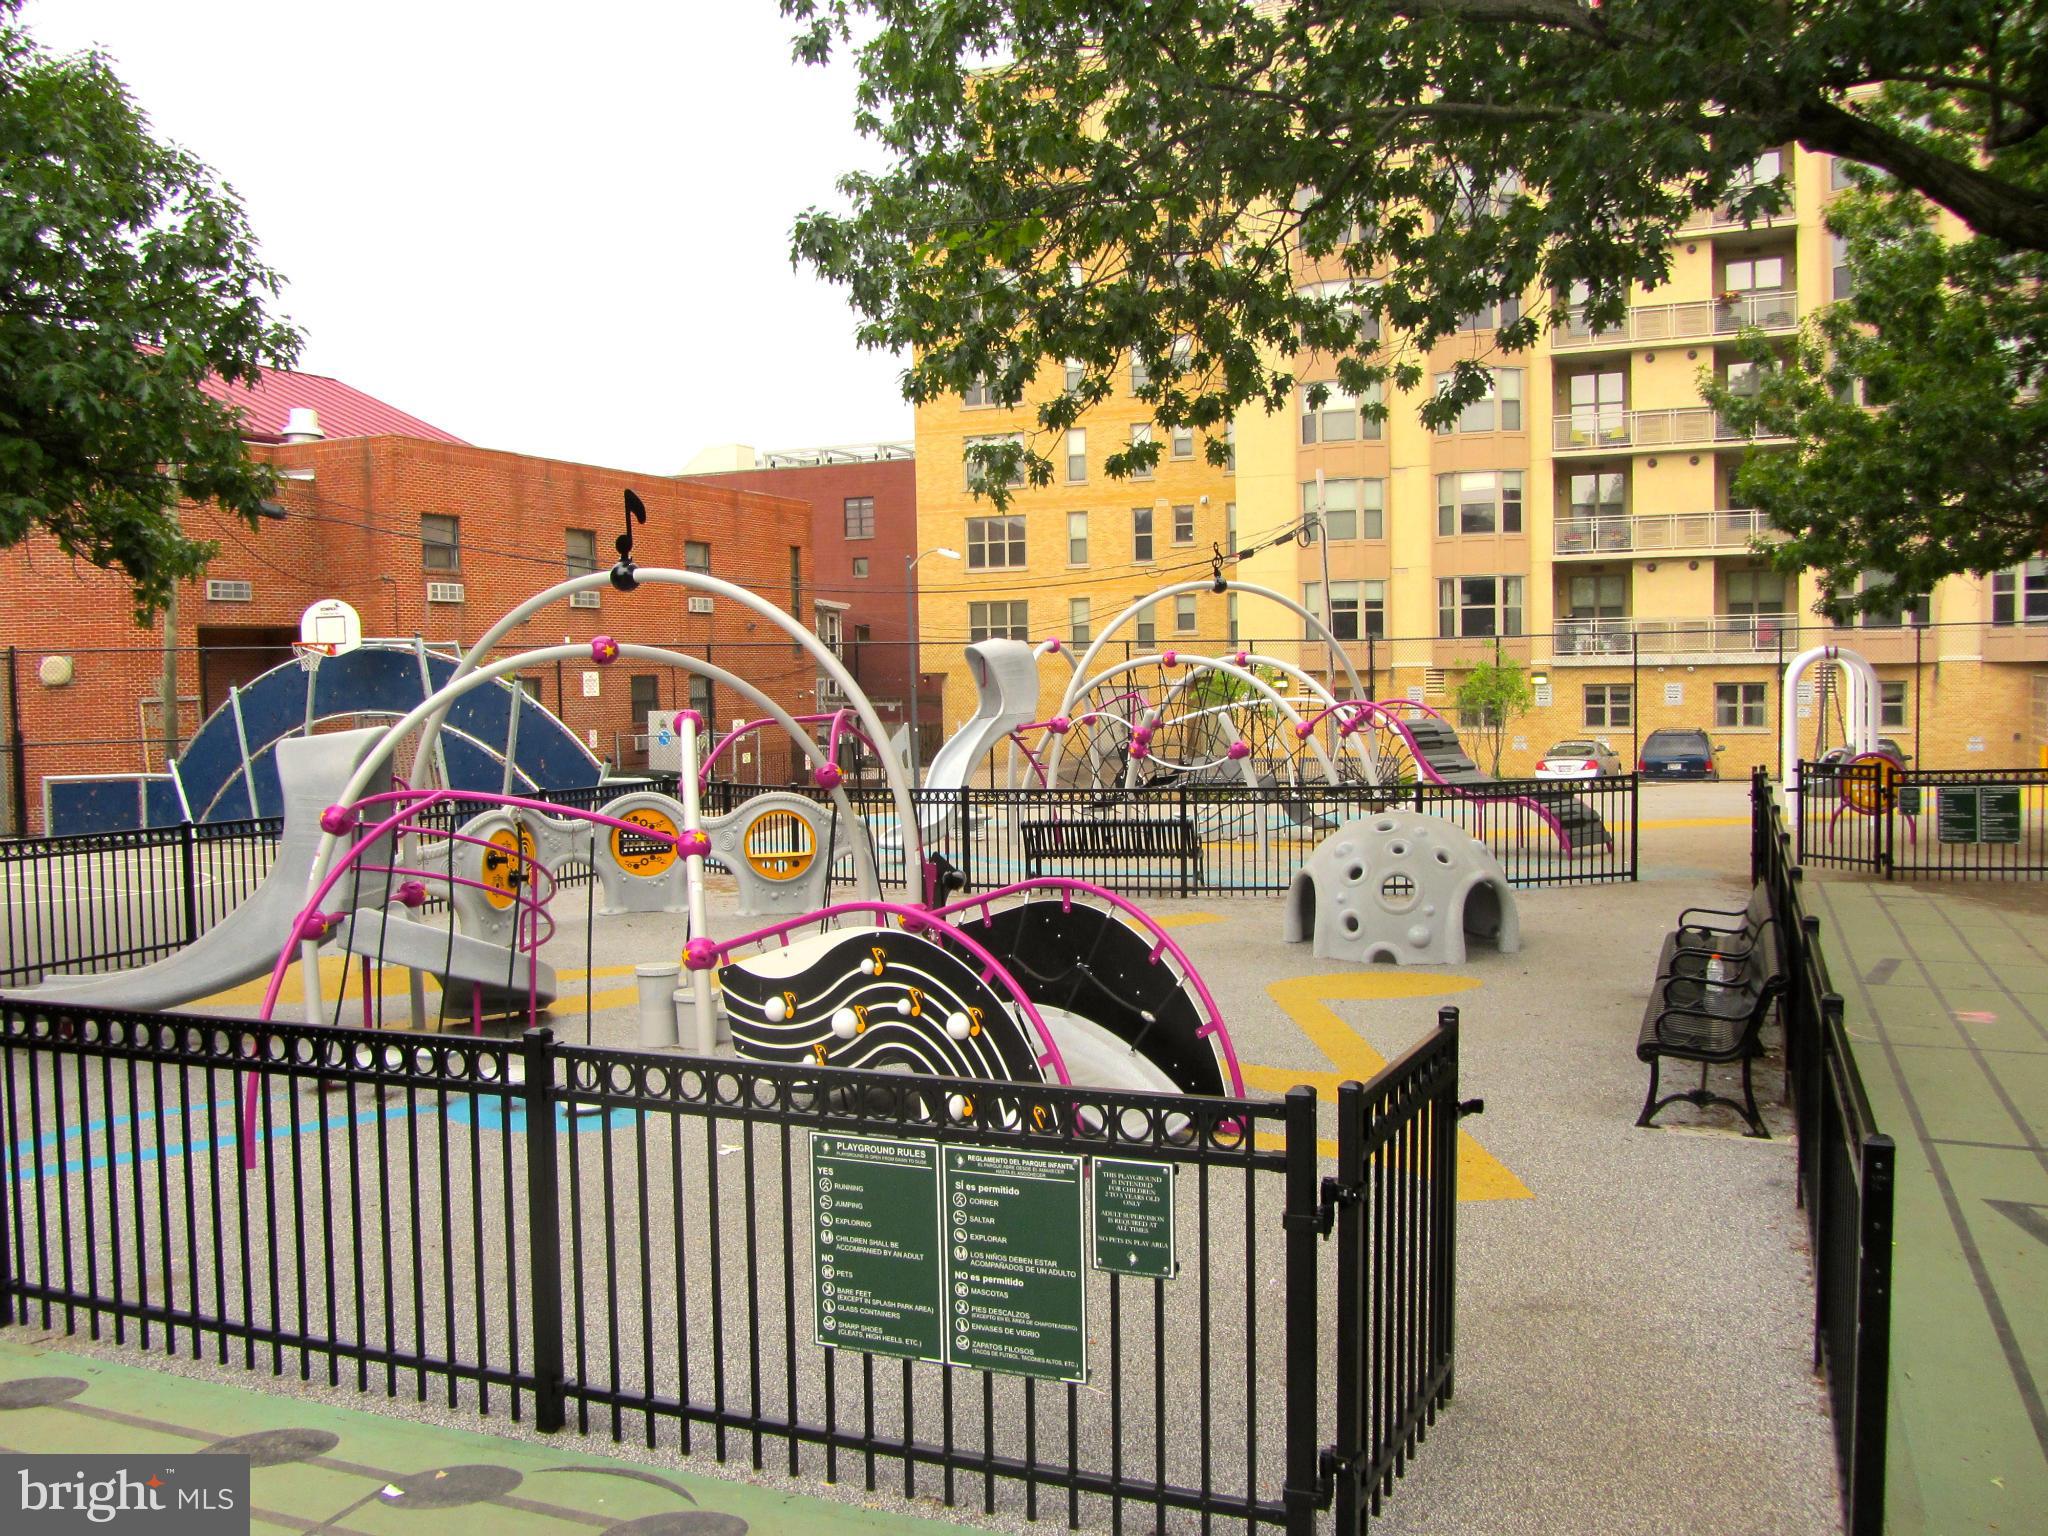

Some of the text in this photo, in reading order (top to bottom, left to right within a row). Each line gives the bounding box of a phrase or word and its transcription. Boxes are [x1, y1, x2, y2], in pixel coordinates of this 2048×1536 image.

[837, 1142, 926, 1158] PLAYGROUND RULES
[968, 1155, 1008, 1164] REGLAMENTO
[1022, 1160, 1046, 1168] PARQUE
[817, 1167, 833, 1175] YES
[1118, 1173, 1162, 1182] PLAYGROUND
[835, 1183, 863, 1192] RUNNING
[1118, 1180, 1152, 1188] INTENDED
[978, 1185, 1020, 1195] permitido
[1122, 1187, 1156, 1195] CHILDREN
[835, 1201, 863, 1209] JUMPING
[969, 1198, 998, 1207] CORRER
[969, 1216, 995, 1224] SALTAR
[1101, 1210, 1164, 1222] ADULT SUPERVISION
[836, 1218, 871, 1228] EXPLORING
[1115, 1219, 1148, 1227] REQUIRED
[836, 1235, 868, 1244] CHILDREN
[870, 1239, 888, 1247] SHALL
[970, 1234, 1007, 1243] EXPLORAR
[836, 1245, 882, 1255] ACCOMPANIED
[903, 1252, 924, 1260] ADULT
[822, 1254, 833, 1262] NO
[986, 1252, 1007, 1261] NIÑOS
[1009, 1256, 1033, 1265] DEBEN
[1035, 1259, 1057, 1267] ESTAR
[837, 1270, 853, 1278] PETS
[970, 1261, 1023, 1272] ACOMPAÑADOS
[1048, 1269, 1076, 1278] ADULTO
[955, 1272, 968, 1280] NO
[983, 1276, 1023, 1286] permitido
[837, 1288, 853, 1296] BARE
[971, 1288, 1008, 1298] MASCOTAS
[837, 1295, 862, 1304] (EXCEPT
[872, 1300, 896, 1308] SPLASH
[915, 1305, 934, 1314] AREA)
[838, 1305, 900, 1319] GLASS CONTAINERS
[989, 1308, 1030, 1319] DESCALZOS
[838, 1328, 864, 1338] (CLEATS,
[861, 1325, 882, 1334] SHOES
[972, 1324, 1003, 1333] ENVASES
[1016, 1329, 1040, 1338] VIDRIO
[972, 1341, 1034, 1355] ZAPATOS FILOSOS
